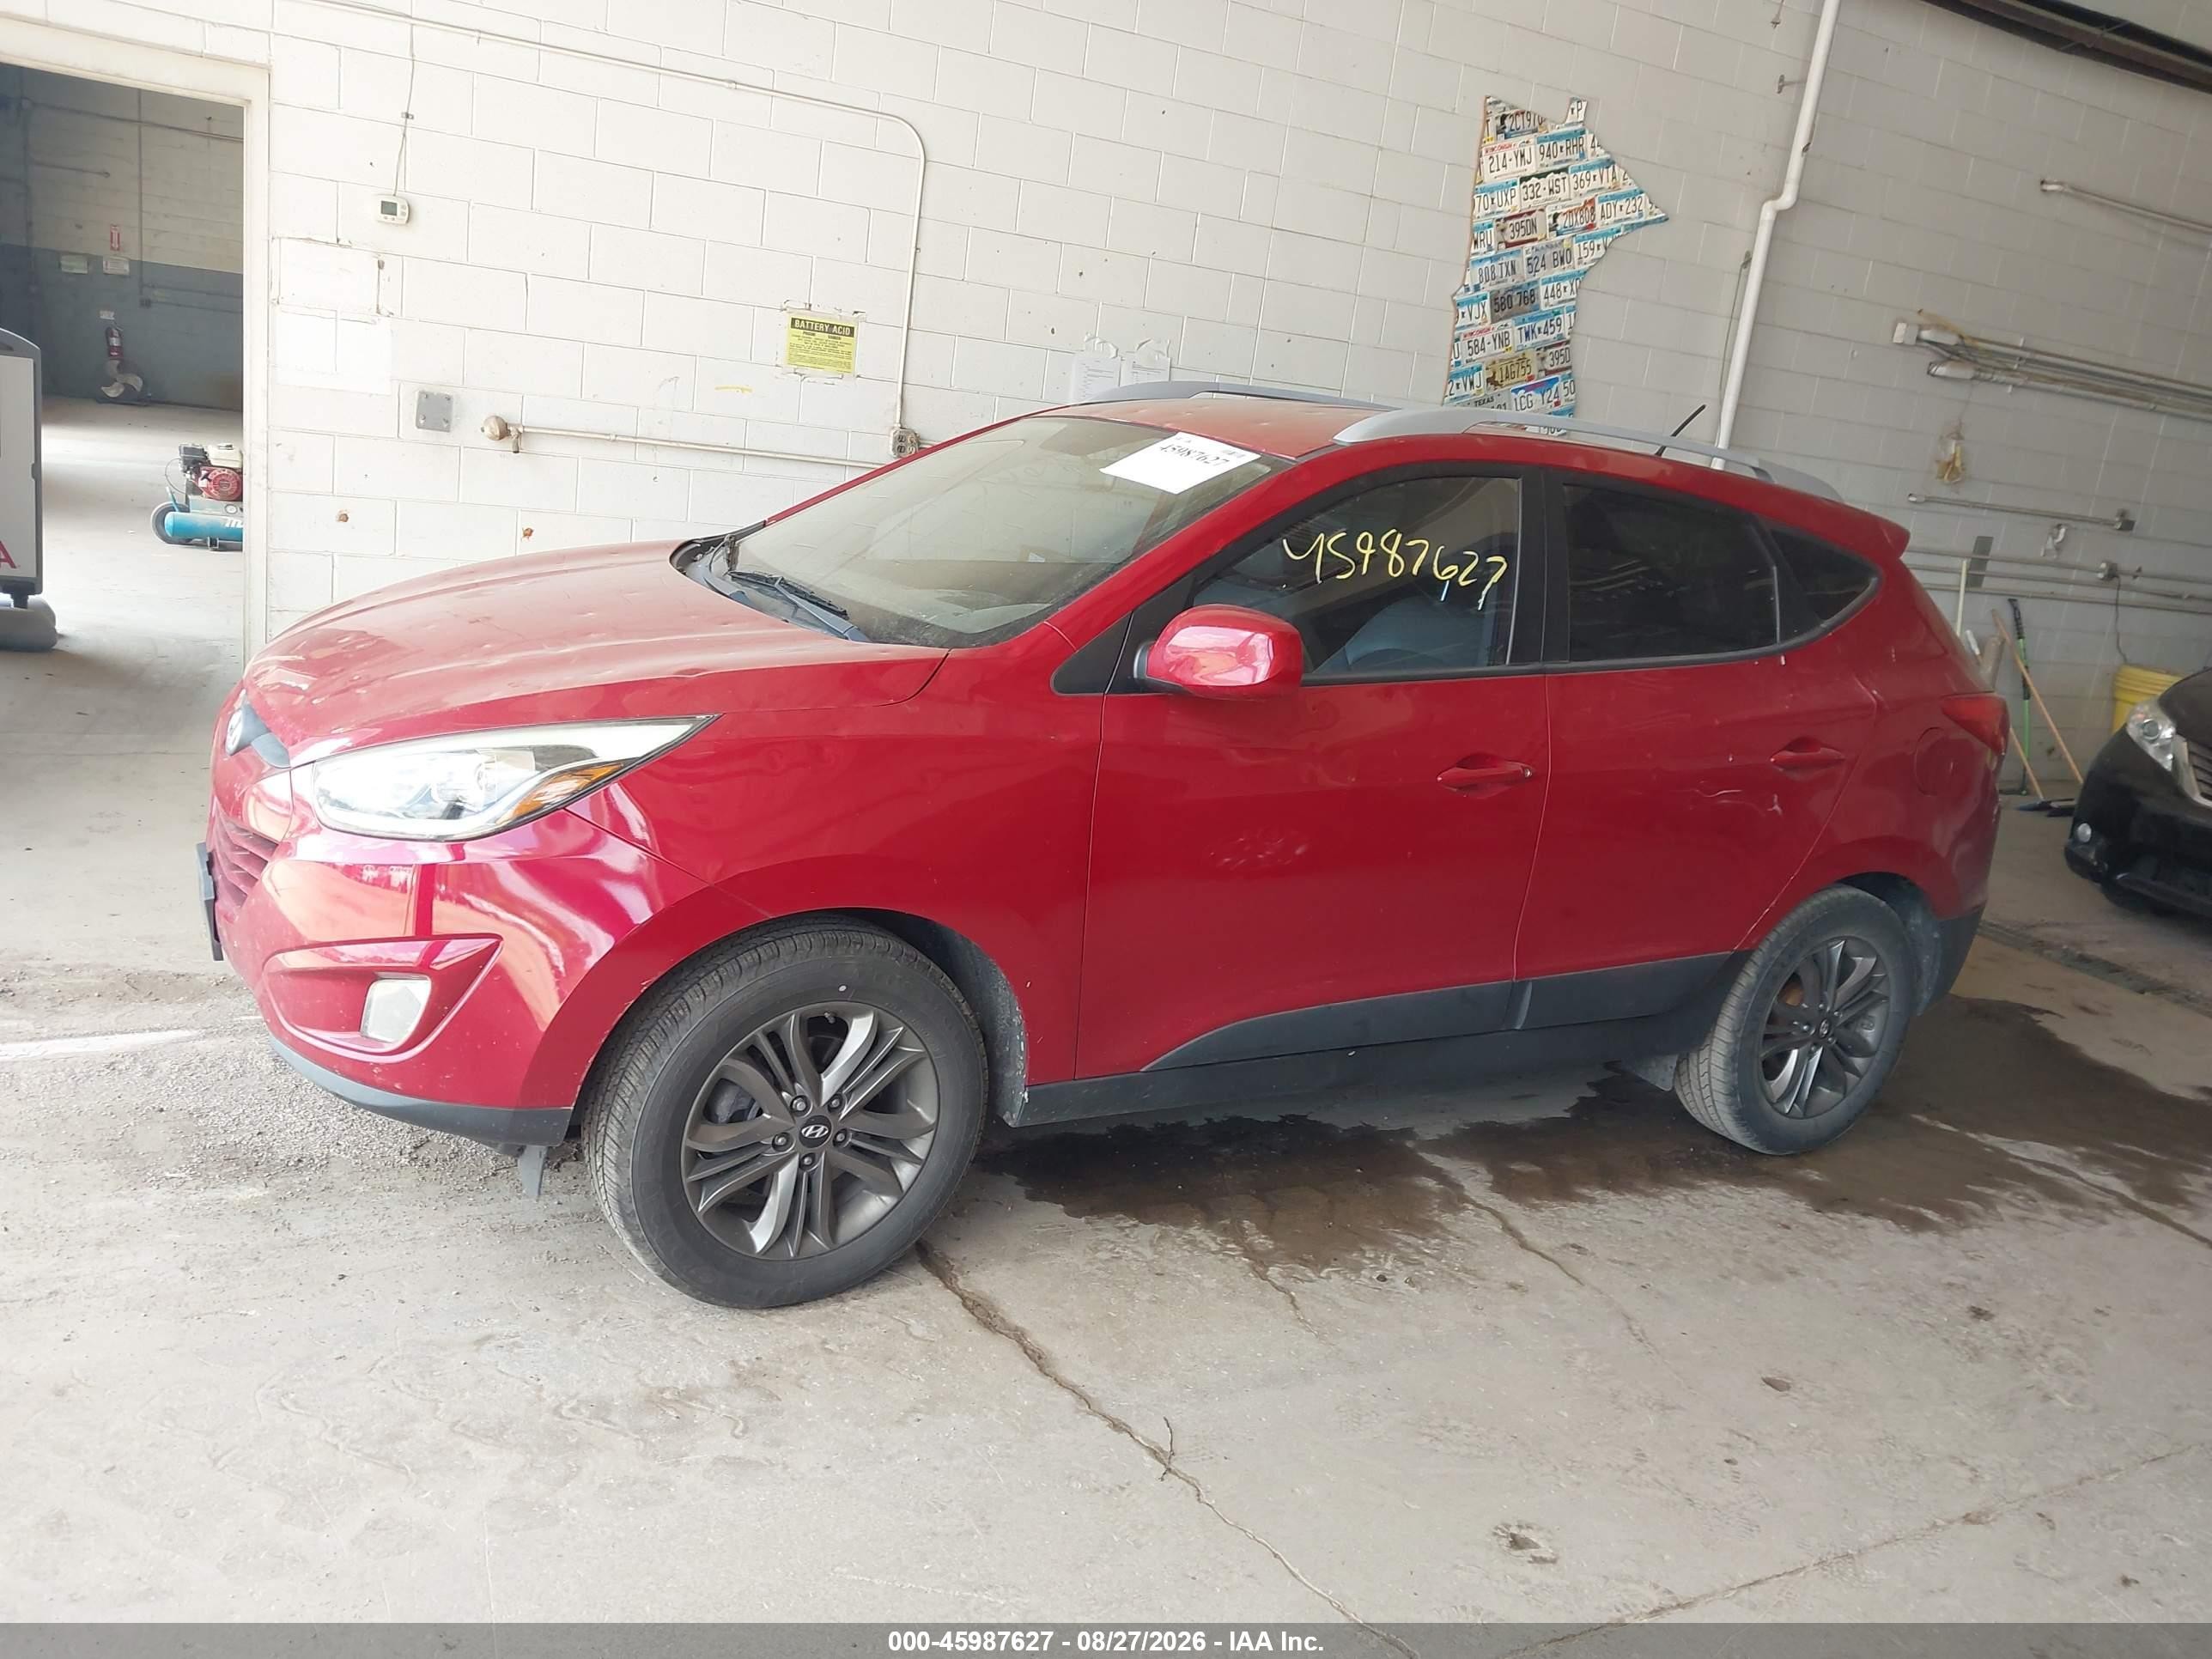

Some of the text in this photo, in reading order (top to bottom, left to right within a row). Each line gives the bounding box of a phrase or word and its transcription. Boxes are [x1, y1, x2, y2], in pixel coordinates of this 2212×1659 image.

[1540, 137, 1584, 161] 940 RHR
[1573, 171, 1590, 190] 369
[1497, 188, 1516, 207] UXP
[1601, 200, 1619, 221] ADY
[1626, 196, 1643, 215] 232
[1577, 240, 1595, 259] 159
[1526, 255, 1546, 275] 524
[1545, 283, 1561, 301] 448
[1468, 301, 1486, 321] VJX
[794, 319, 851, 336] BATTERY ACID
[1518, 324, 1537, 343] TWK
[1543, 317, 1562, 336] 459
[1474, 397, 1494, 407] TEXAS
[1540, 386, 1559, 404] Y24
